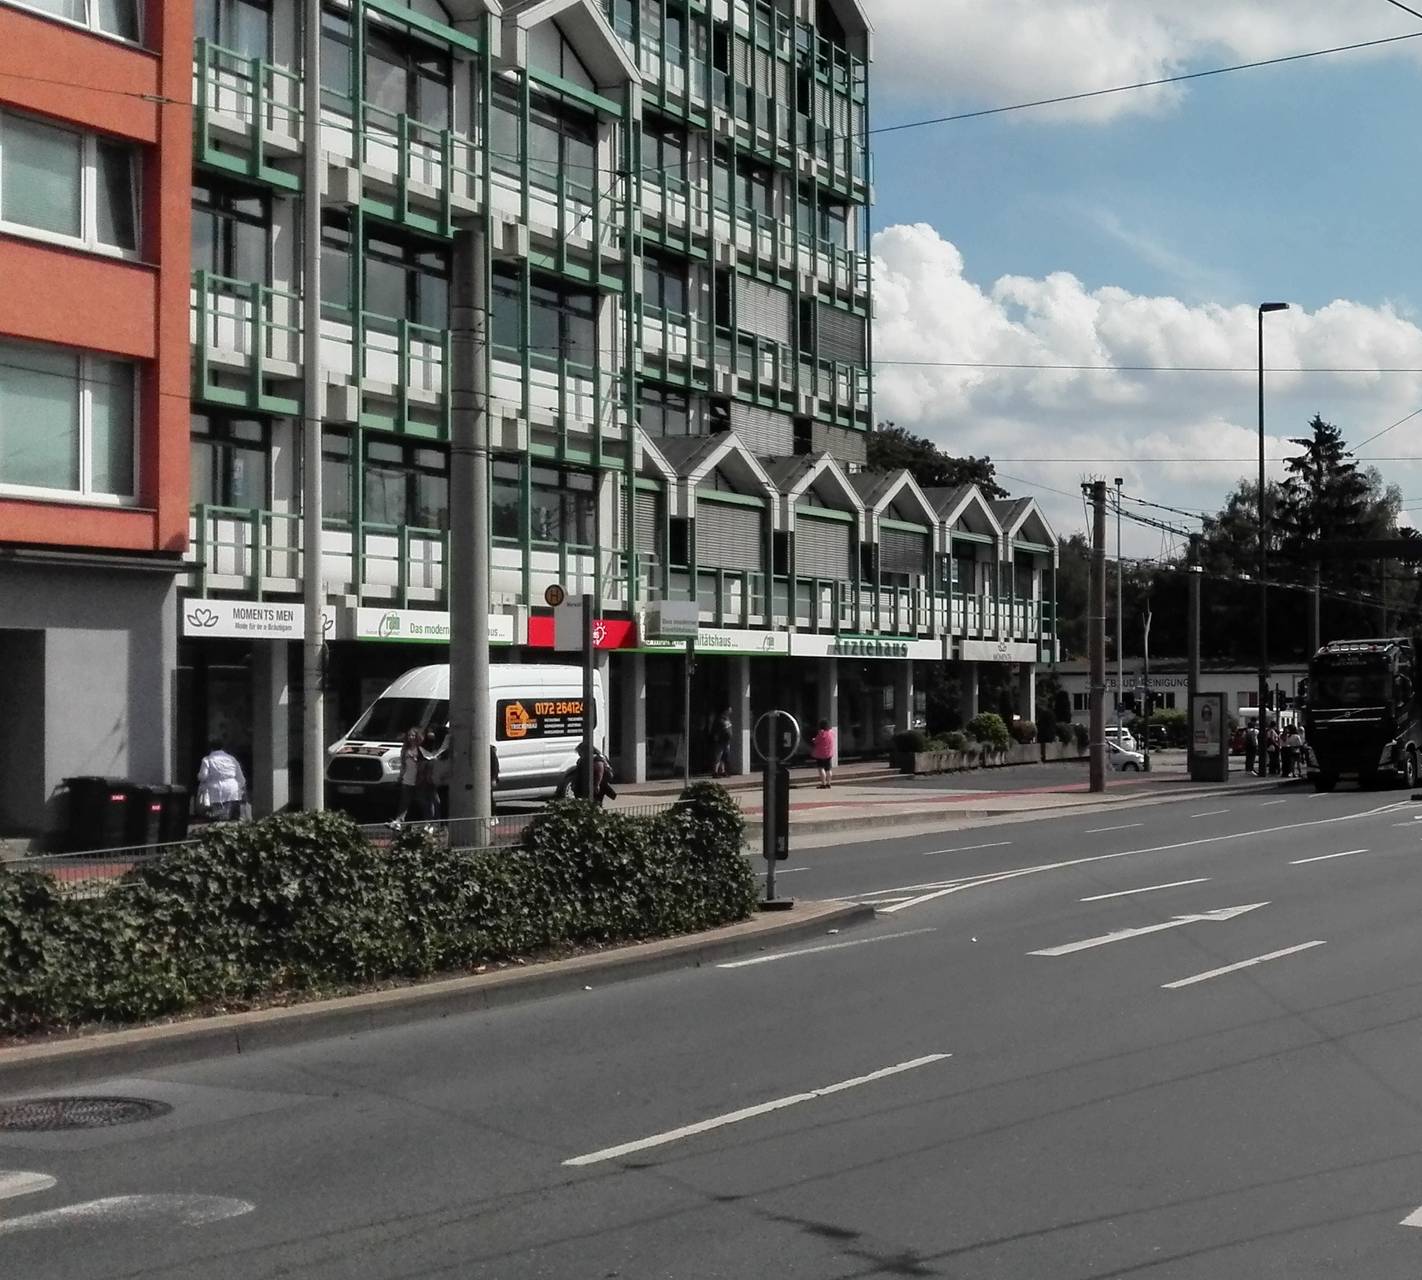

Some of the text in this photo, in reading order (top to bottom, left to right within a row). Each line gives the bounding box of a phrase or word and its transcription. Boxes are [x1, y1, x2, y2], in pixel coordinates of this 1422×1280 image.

[233, 608, 294, 622] MOMENTS MEN
[410, 622, 423, 634] Das
[424, 623, 450, 636] modern
[535, 702, 555, 715] 0172
